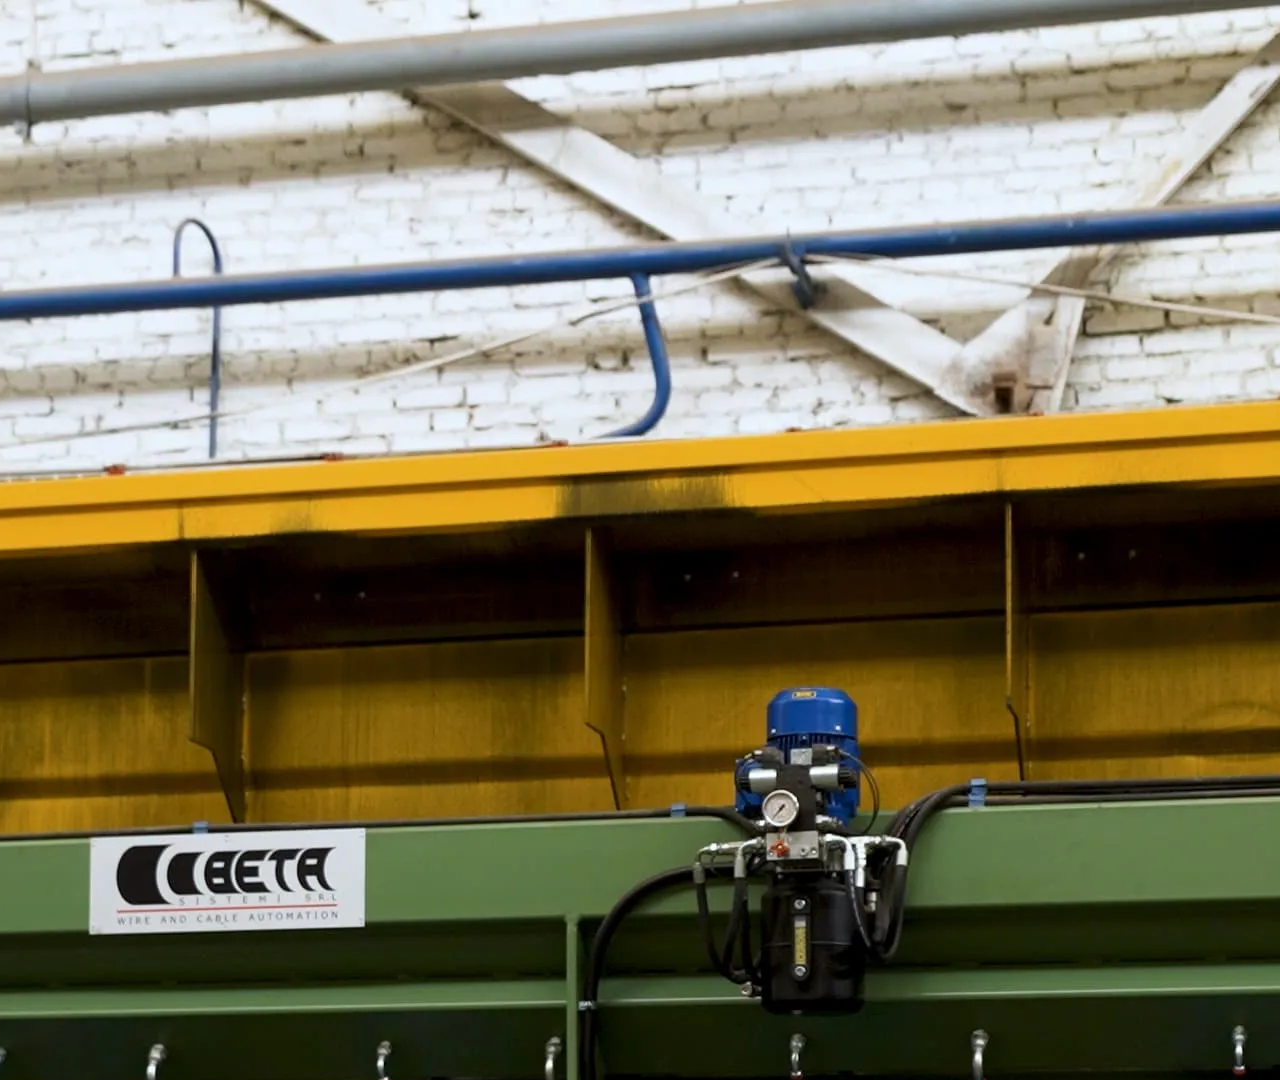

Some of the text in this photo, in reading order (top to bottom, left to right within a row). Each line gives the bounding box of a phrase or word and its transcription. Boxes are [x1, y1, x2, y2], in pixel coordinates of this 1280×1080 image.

[204, 847, 337, 894] BETA
[178, 895, 281, 906] SISTEMI
[117, 910, 339, 925] WIRE AND CABLE AUTOMATION
